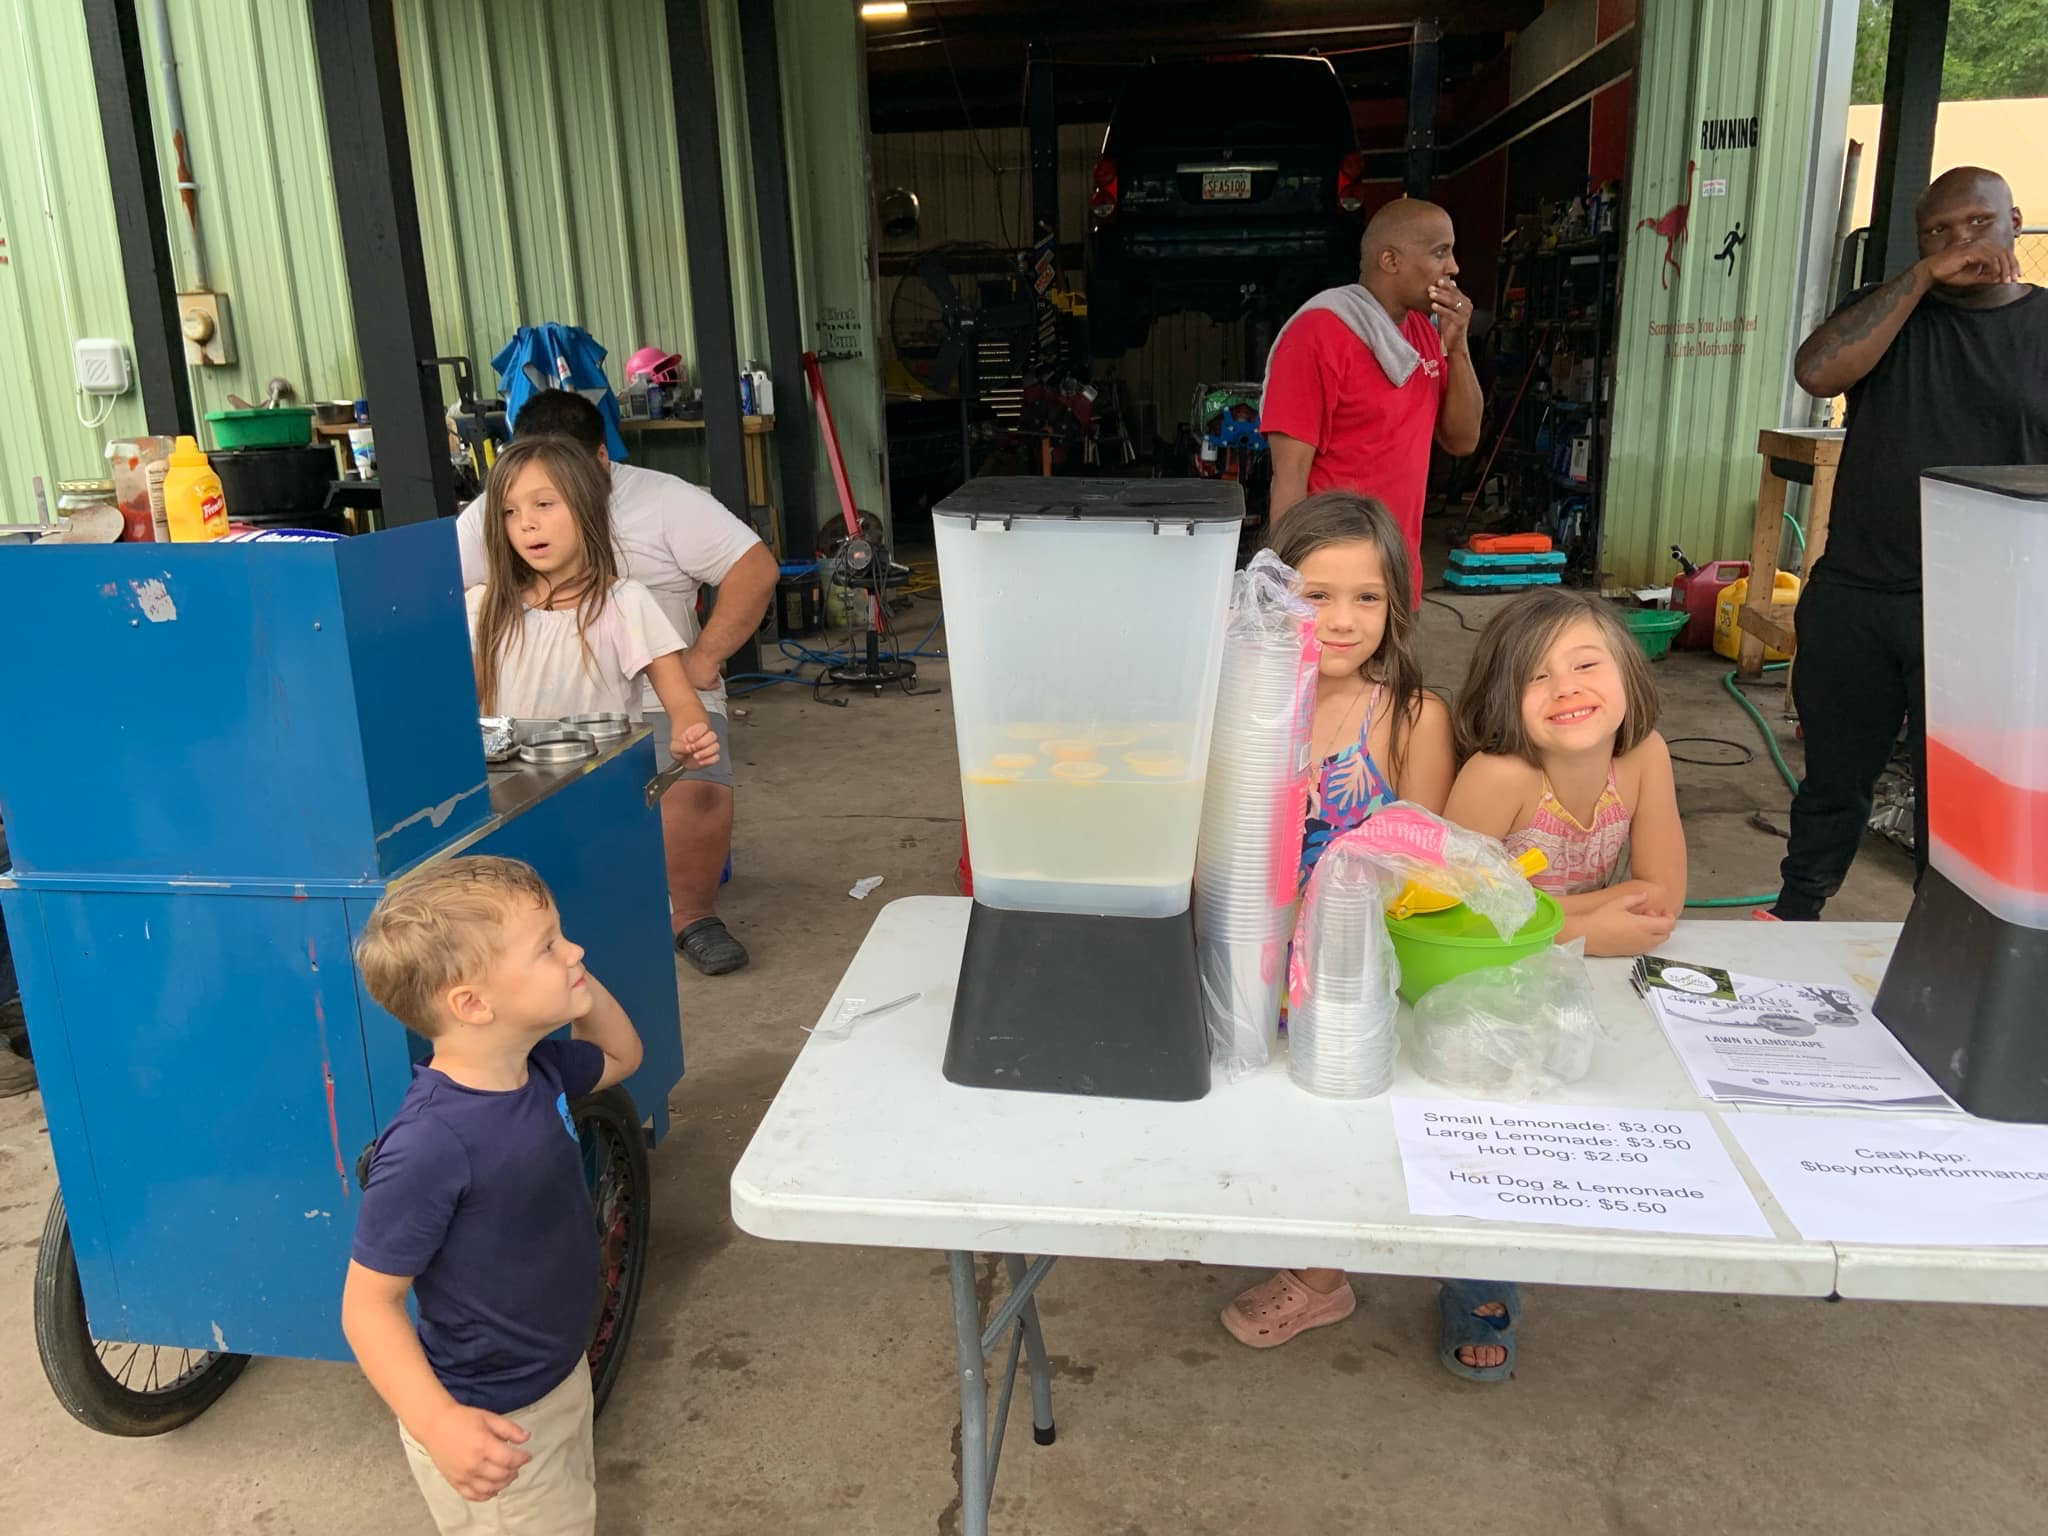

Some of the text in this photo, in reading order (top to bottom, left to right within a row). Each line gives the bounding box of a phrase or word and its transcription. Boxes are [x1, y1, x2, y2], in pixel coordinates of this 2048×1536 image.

[1700, 117, 1759, 151] RUNNING
[1698, 317, 1714, 333] You
[1696, 340, 1745, 357] Motivation
[1706, 1035, 1741, 1045] LAWN
[1754, 1037, 1825, 1050] LANDSCAPE
[1423, 1112, 1682, 1136] Small Lemonade: $3.00
[1426, 1127, 1692, 1151] Large Lemonade: $3.50
[1477, 1145, 1649, 1164] Hot Dog: $2.50
[1855, 1148, 1973, 1164] CashApp:
[1800, 1160, 2048, 1182] $beyondperformance
[1449, 1170, 1705, 1200] Hot Dog & Lemonade
[1497, 1191, 1668, 1215] Combo: $5.50
